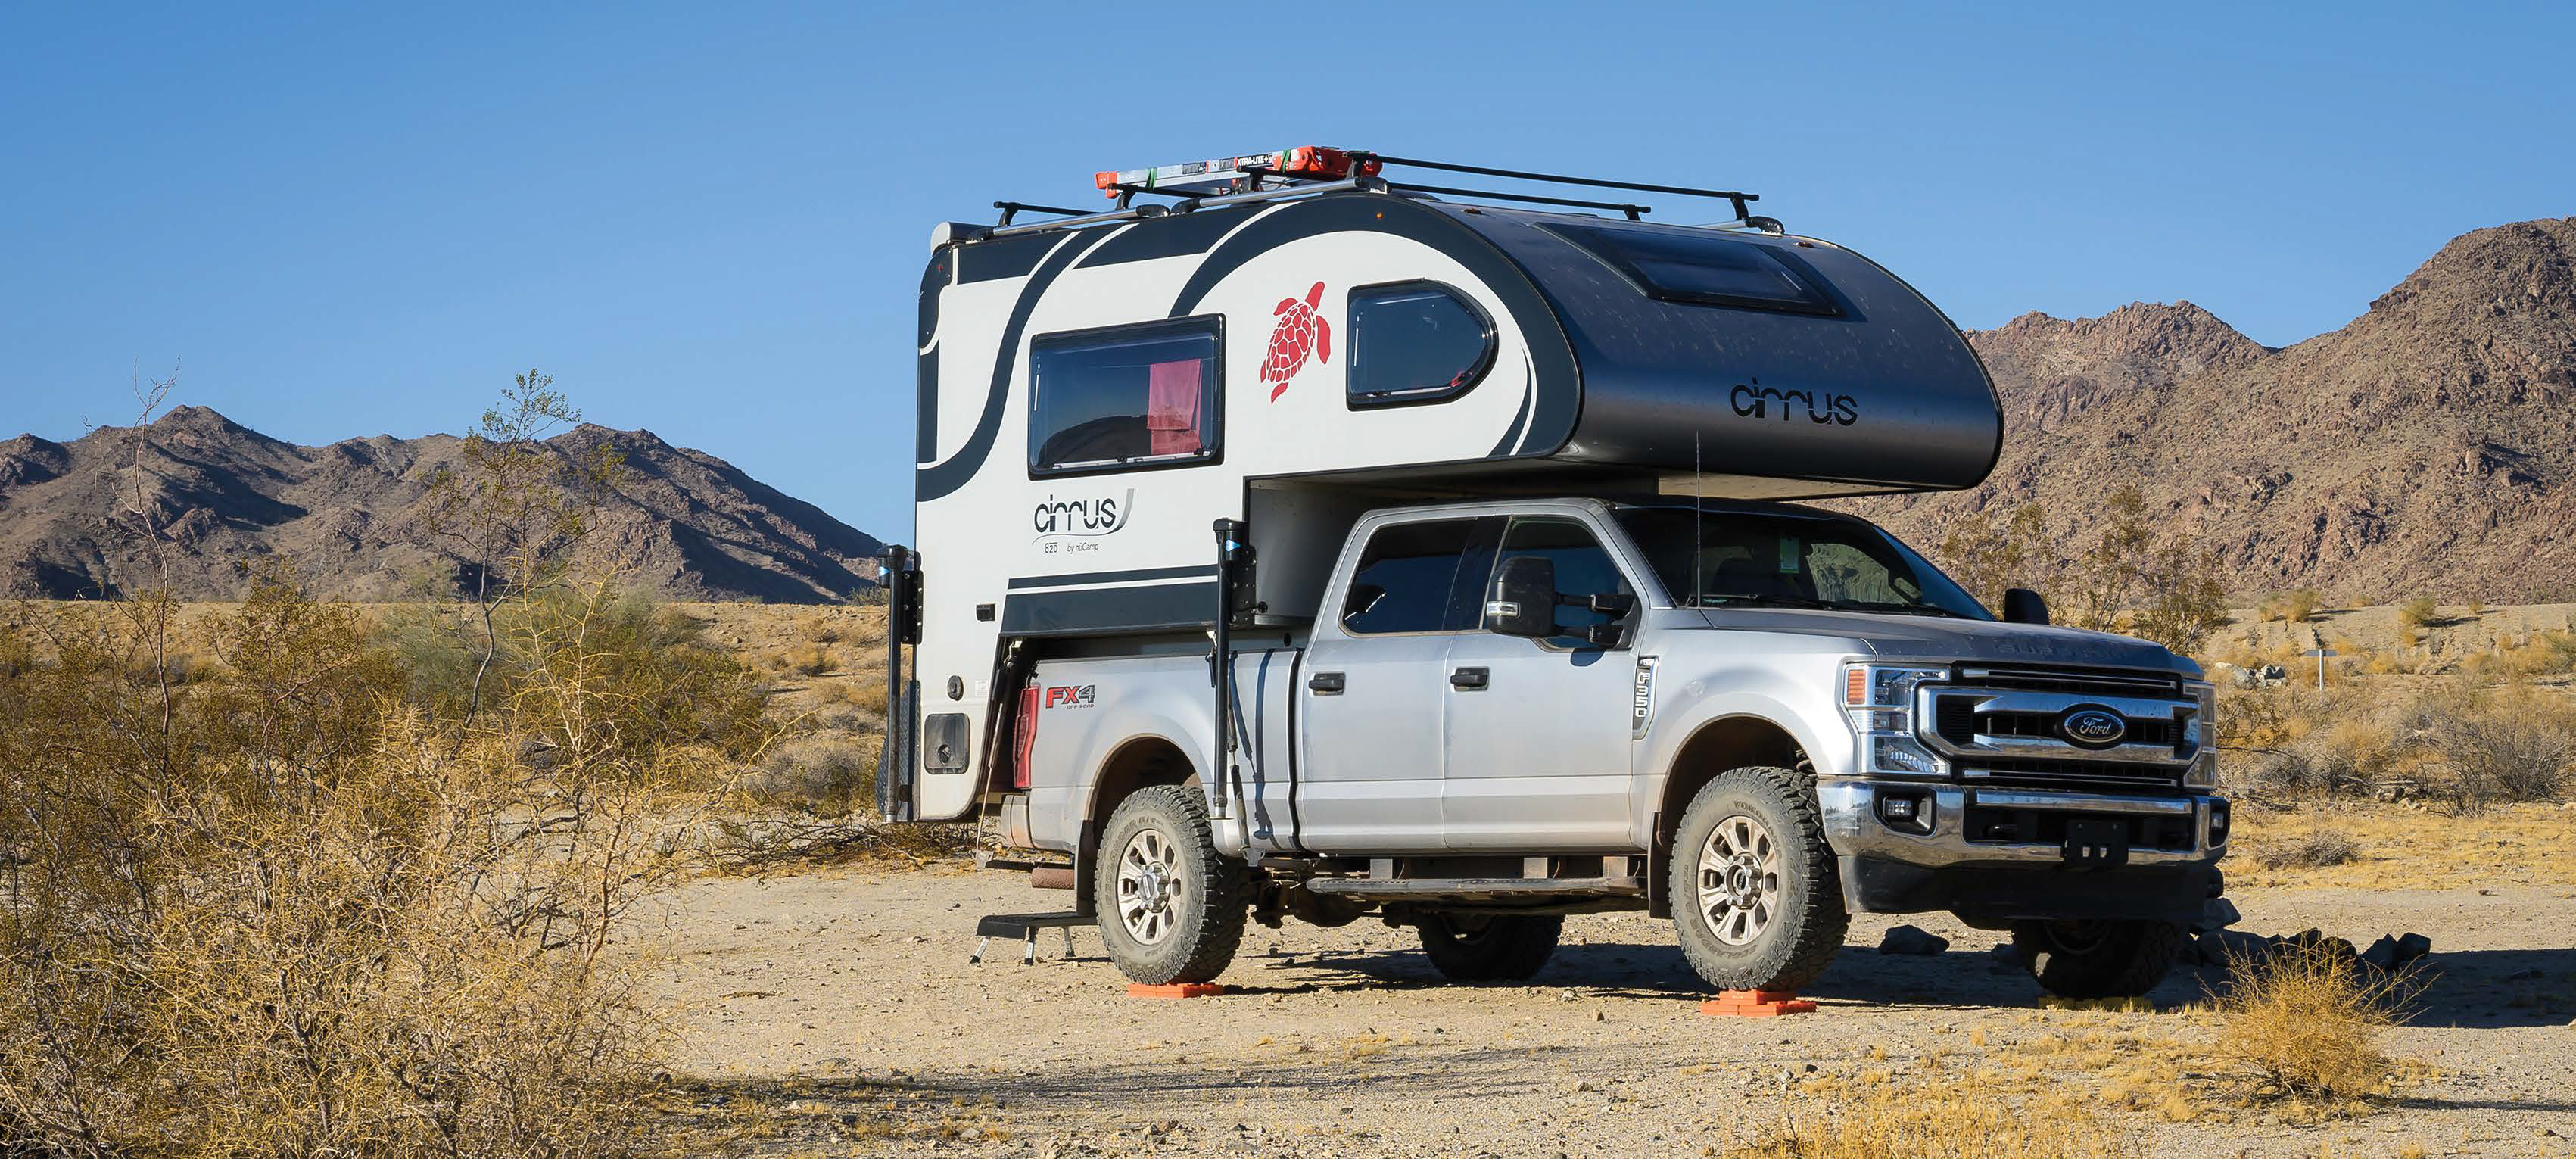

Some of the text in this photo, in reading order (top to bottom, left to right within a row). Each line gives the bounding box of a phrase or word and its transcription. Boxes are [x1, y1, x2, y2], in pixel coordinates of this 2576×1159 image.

[1730, 377, 1858, 427] cirrus
[1034, 494, 1116, 533] cirrus
[1045, 542, 1058, 553] 820
[1067, 541, 1074, 554] by
[1045, 684, 1095, 709] FX4
[2079, 716, 2112, 735] Ford
